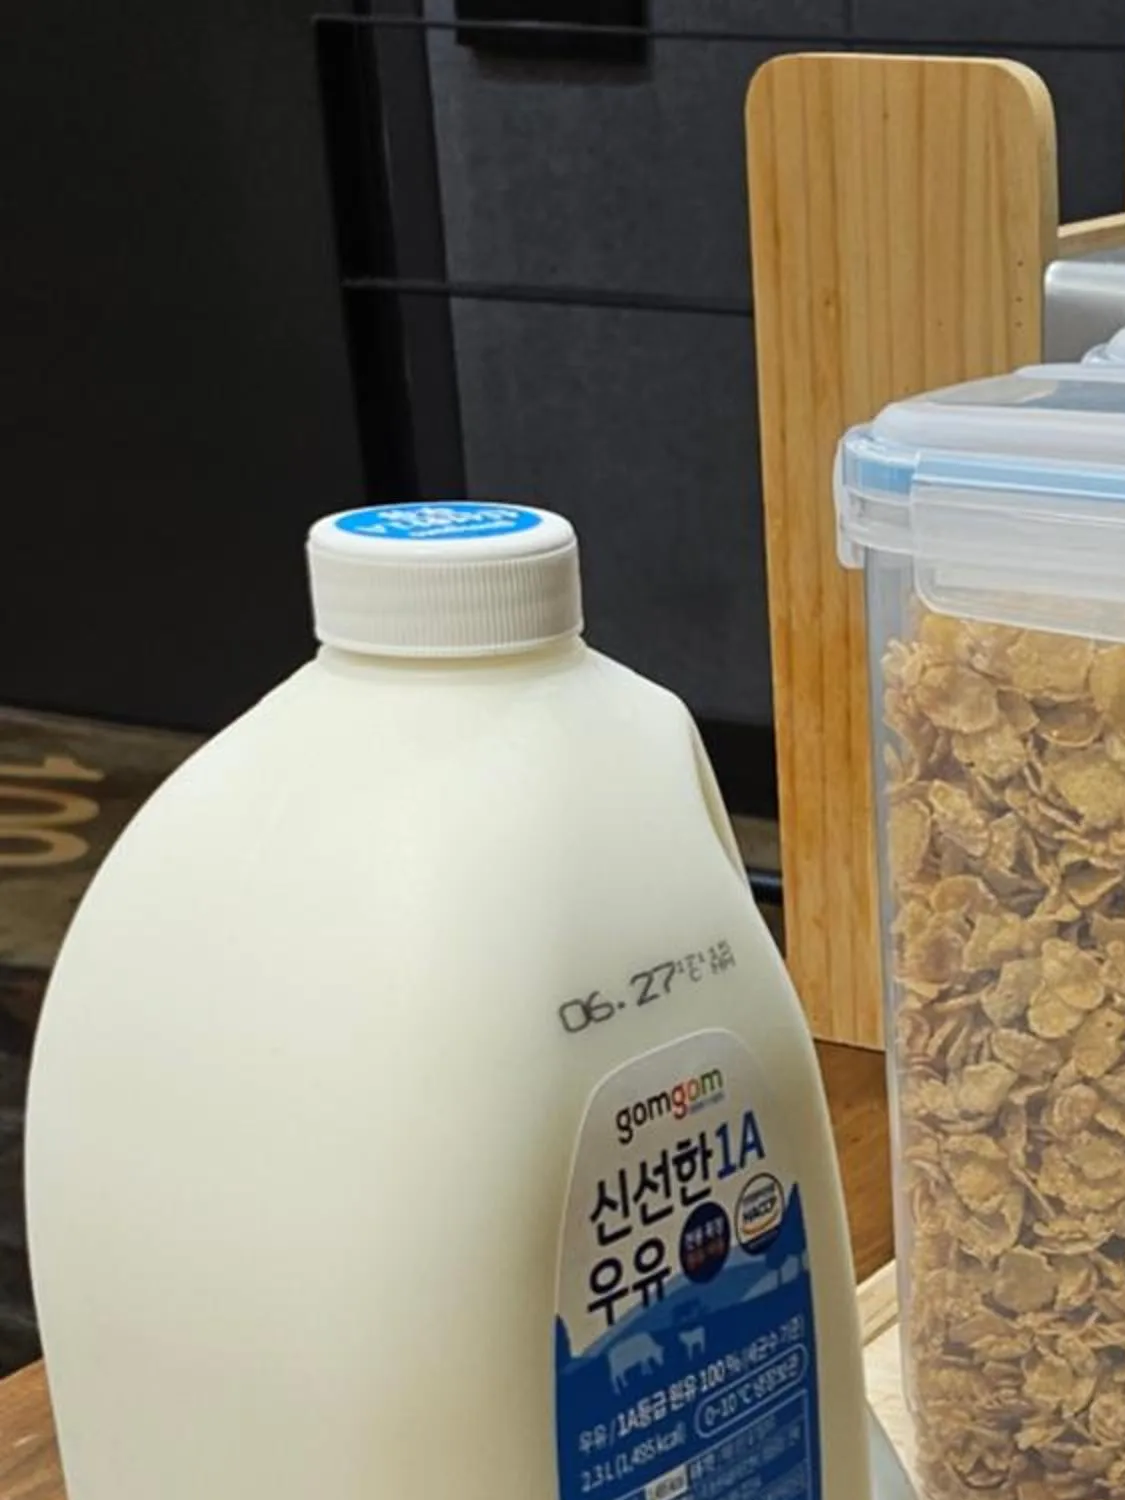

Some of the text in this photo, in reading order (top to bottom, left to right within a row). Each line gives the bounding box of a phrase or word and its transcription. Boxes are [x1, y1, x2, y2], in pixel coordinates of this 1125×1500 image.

[558, 959, 677, 1034] 06.27
[616, 1065, 725, 1145] gomgom
[587, 1236, 673, 1327] 우유
